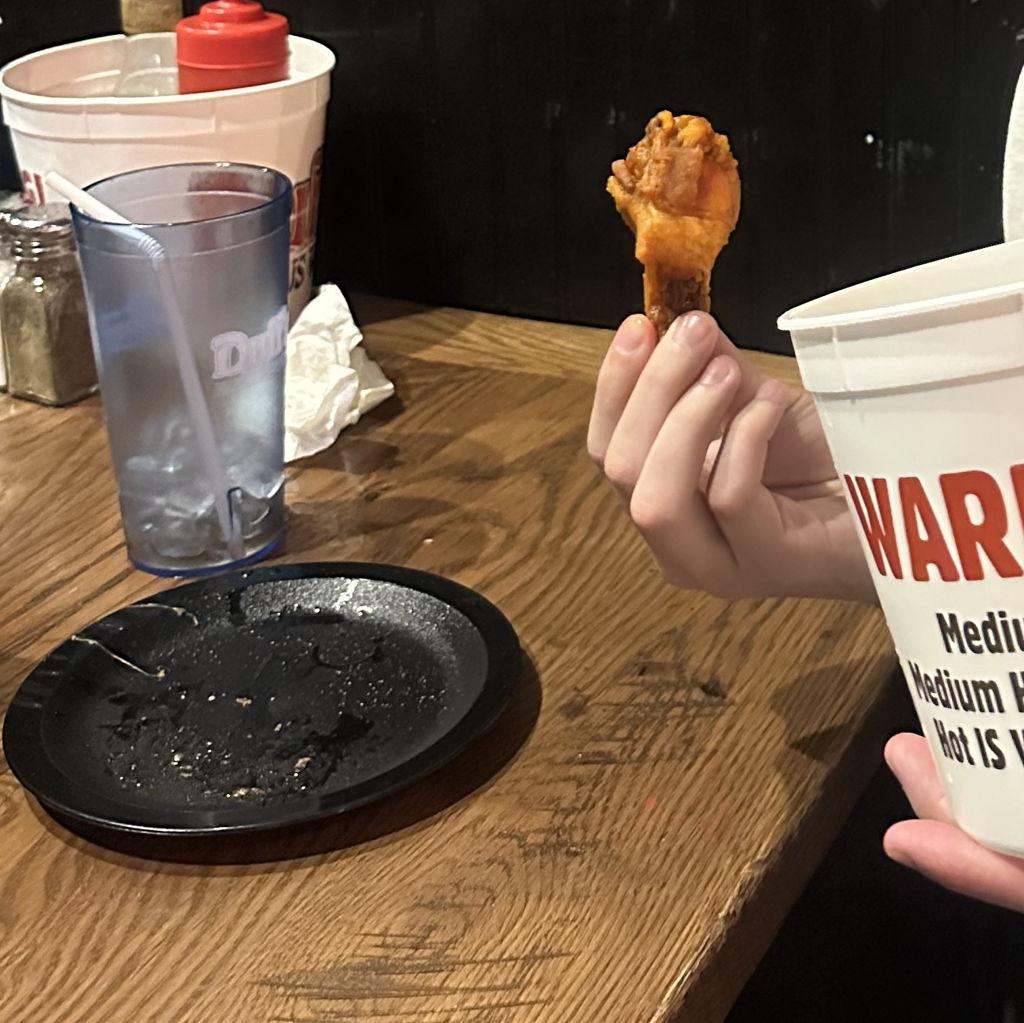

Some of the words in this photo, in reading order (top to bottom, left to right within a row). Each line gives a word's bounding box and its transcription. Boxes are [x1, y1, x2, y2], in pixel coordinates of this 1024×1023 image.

[908, 660, 1005, 714] Medium
[933, 717, 976, 766] Hot
[974, 727, 1006, 770] IS
